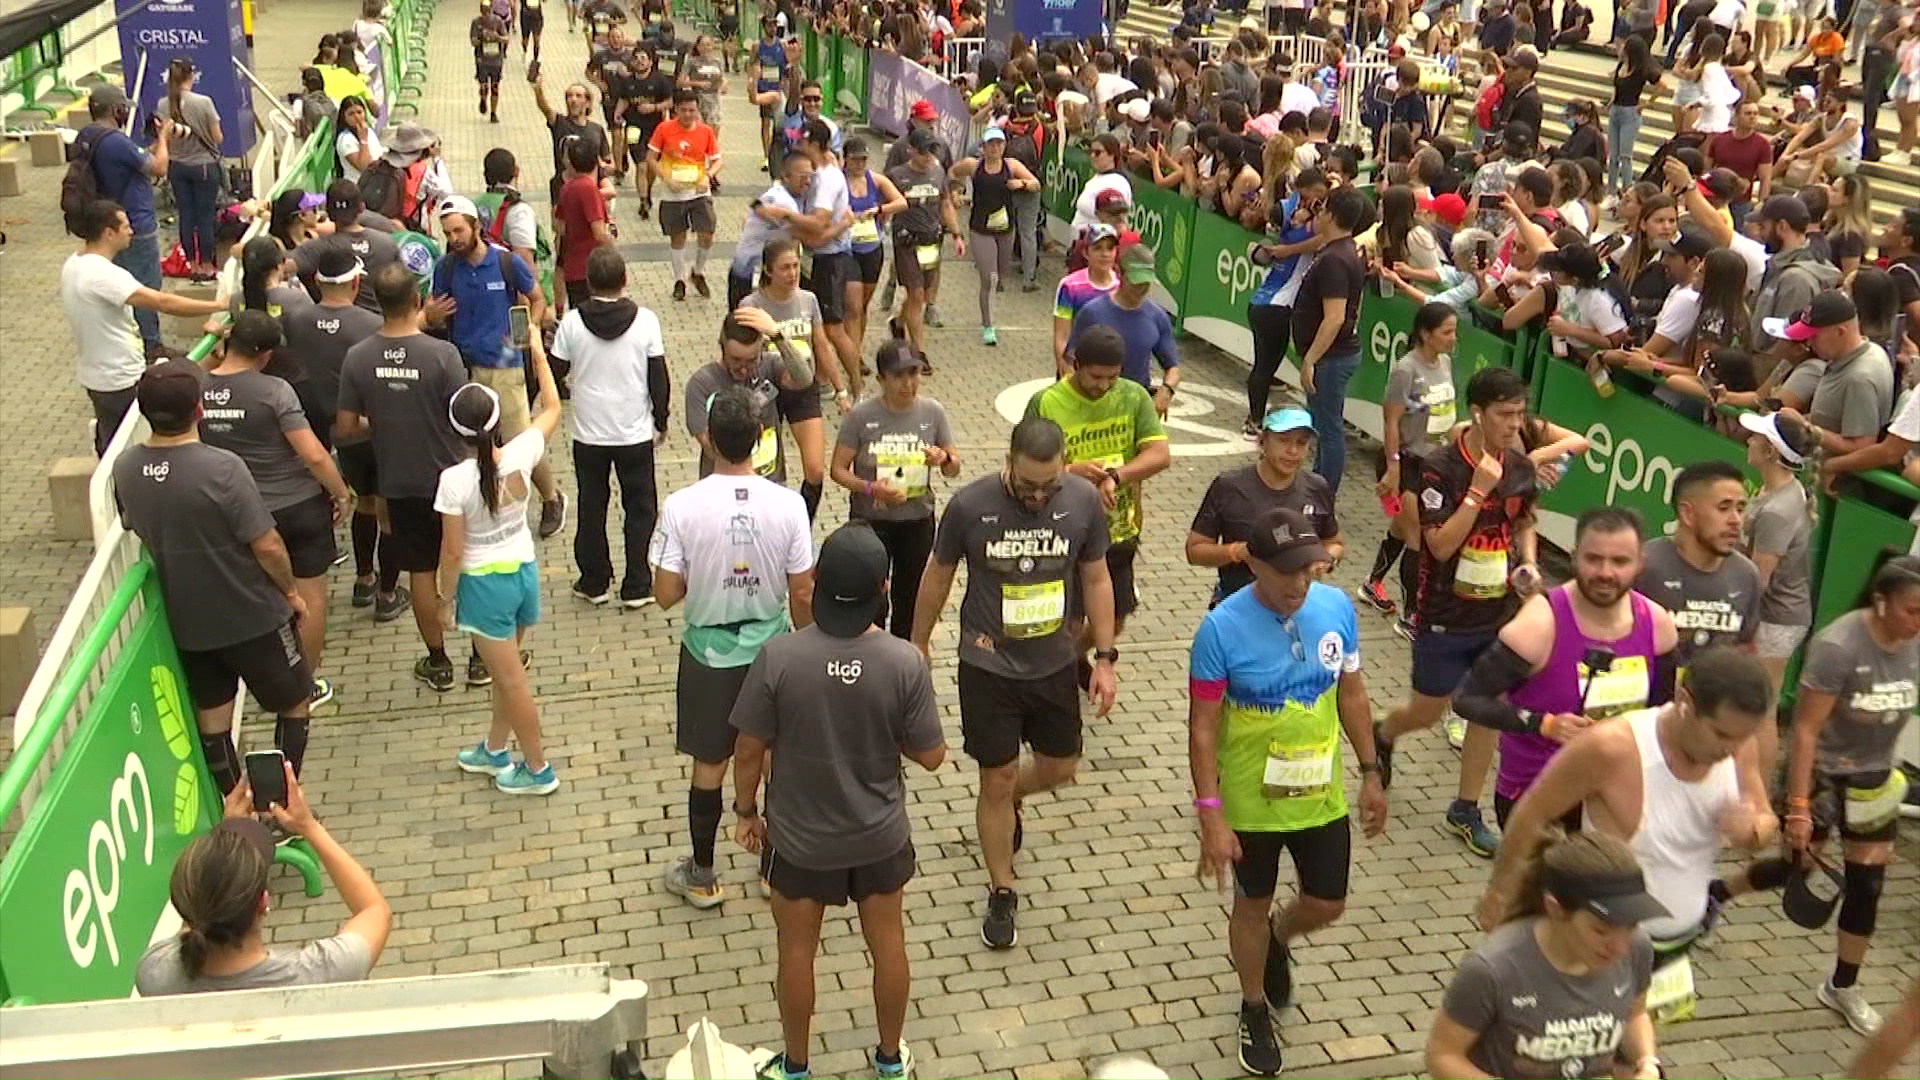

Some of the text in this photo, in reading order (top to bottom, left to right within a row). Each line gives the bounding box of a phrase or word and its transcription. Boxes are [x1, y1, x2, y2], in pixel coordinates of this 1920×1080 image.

[140, 29, 208, 44] CRISTAL
[1003, 528, 1054, 540] MARATÓN
[985, 535, 1070, 559] MEDELLÍN
[63, 750, 155, 968] epm
